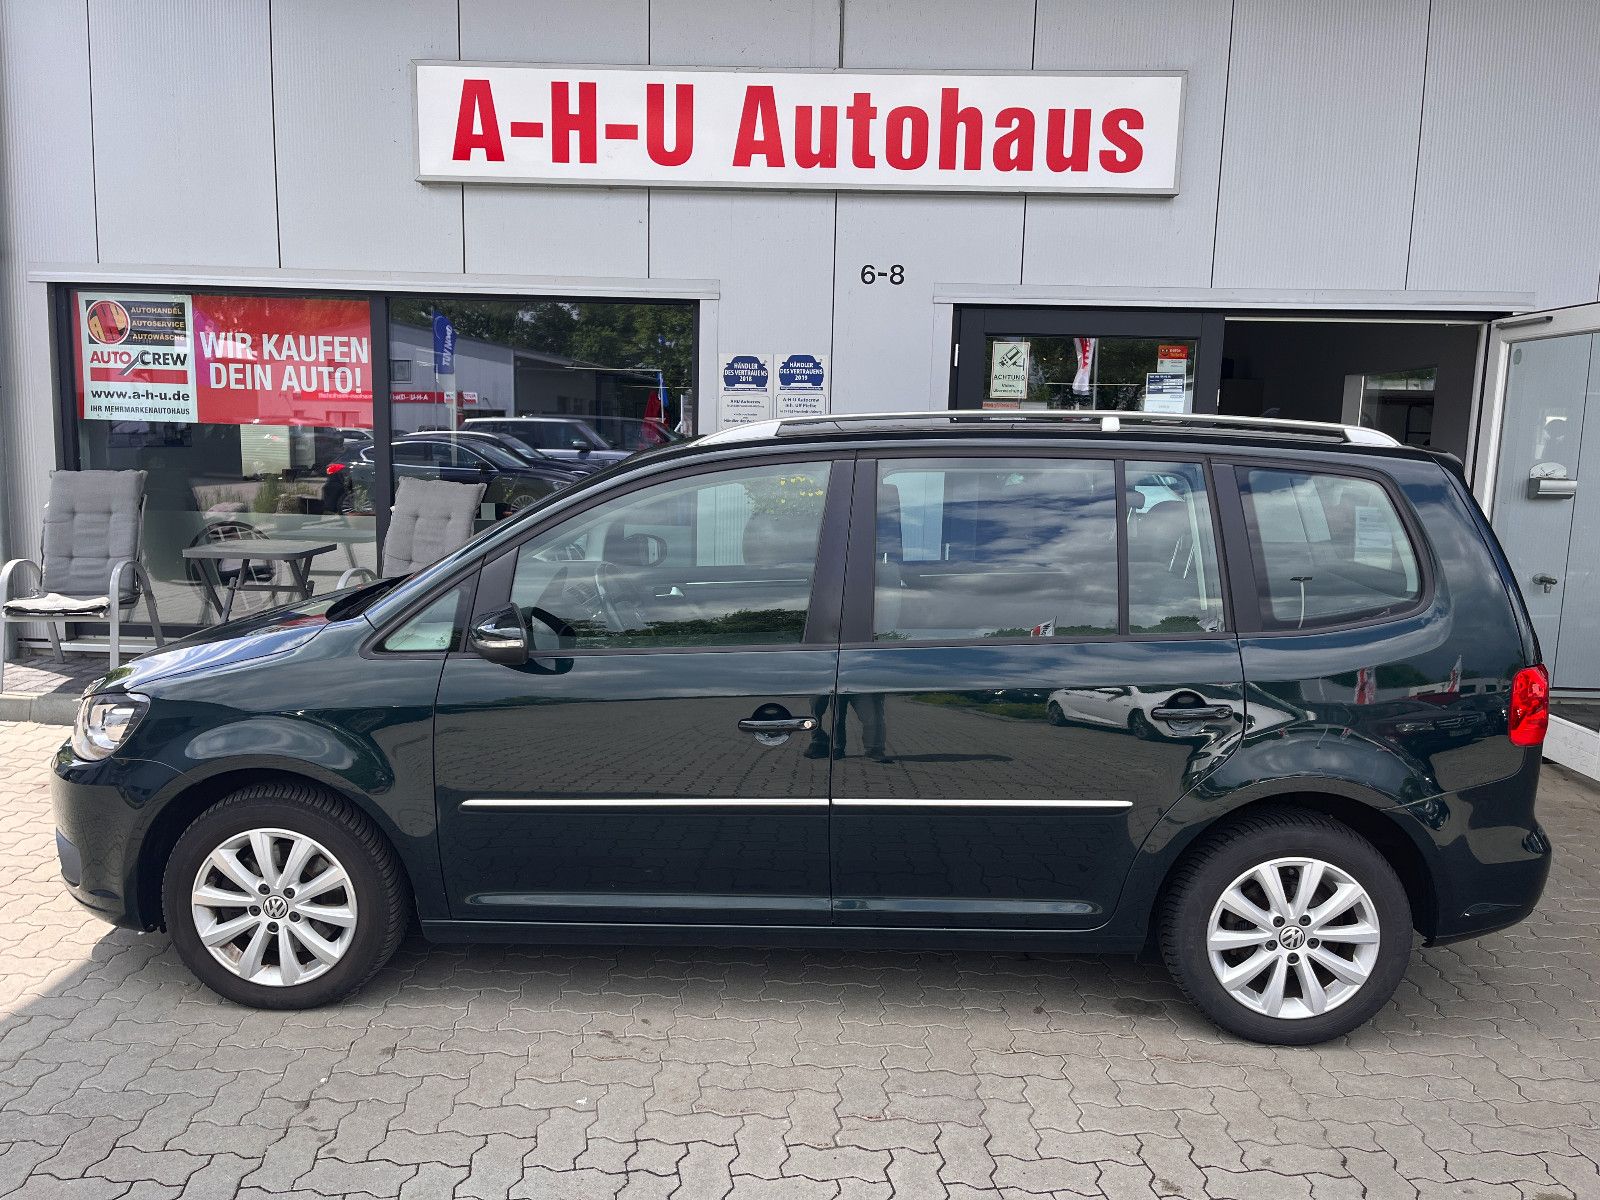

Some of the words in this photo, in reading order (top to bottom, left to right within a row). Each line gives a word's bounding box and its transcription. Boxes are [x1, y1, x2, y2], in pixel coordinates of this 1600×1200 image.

[452, 79, 694, 167] A-H-U
[732, 85, 1144, 173] Autohaus
[860, 264, 905, 285] 6-8
[131, 306, 182, 315] AUTOHANDEL
[132, 320, 185, 328] AUTOSERVICE
[199, 331, 253, 359] WIR
[262, 333, 369, 364] KAUFEN
[209, 363, 272, 391] DEIN
[280, 365, 362, 394] AUTO!
[91, 390, 190, 401] www.a-h-u.de
[104, 405, 190, 415] MEHRMARKENAUTOHAUS
